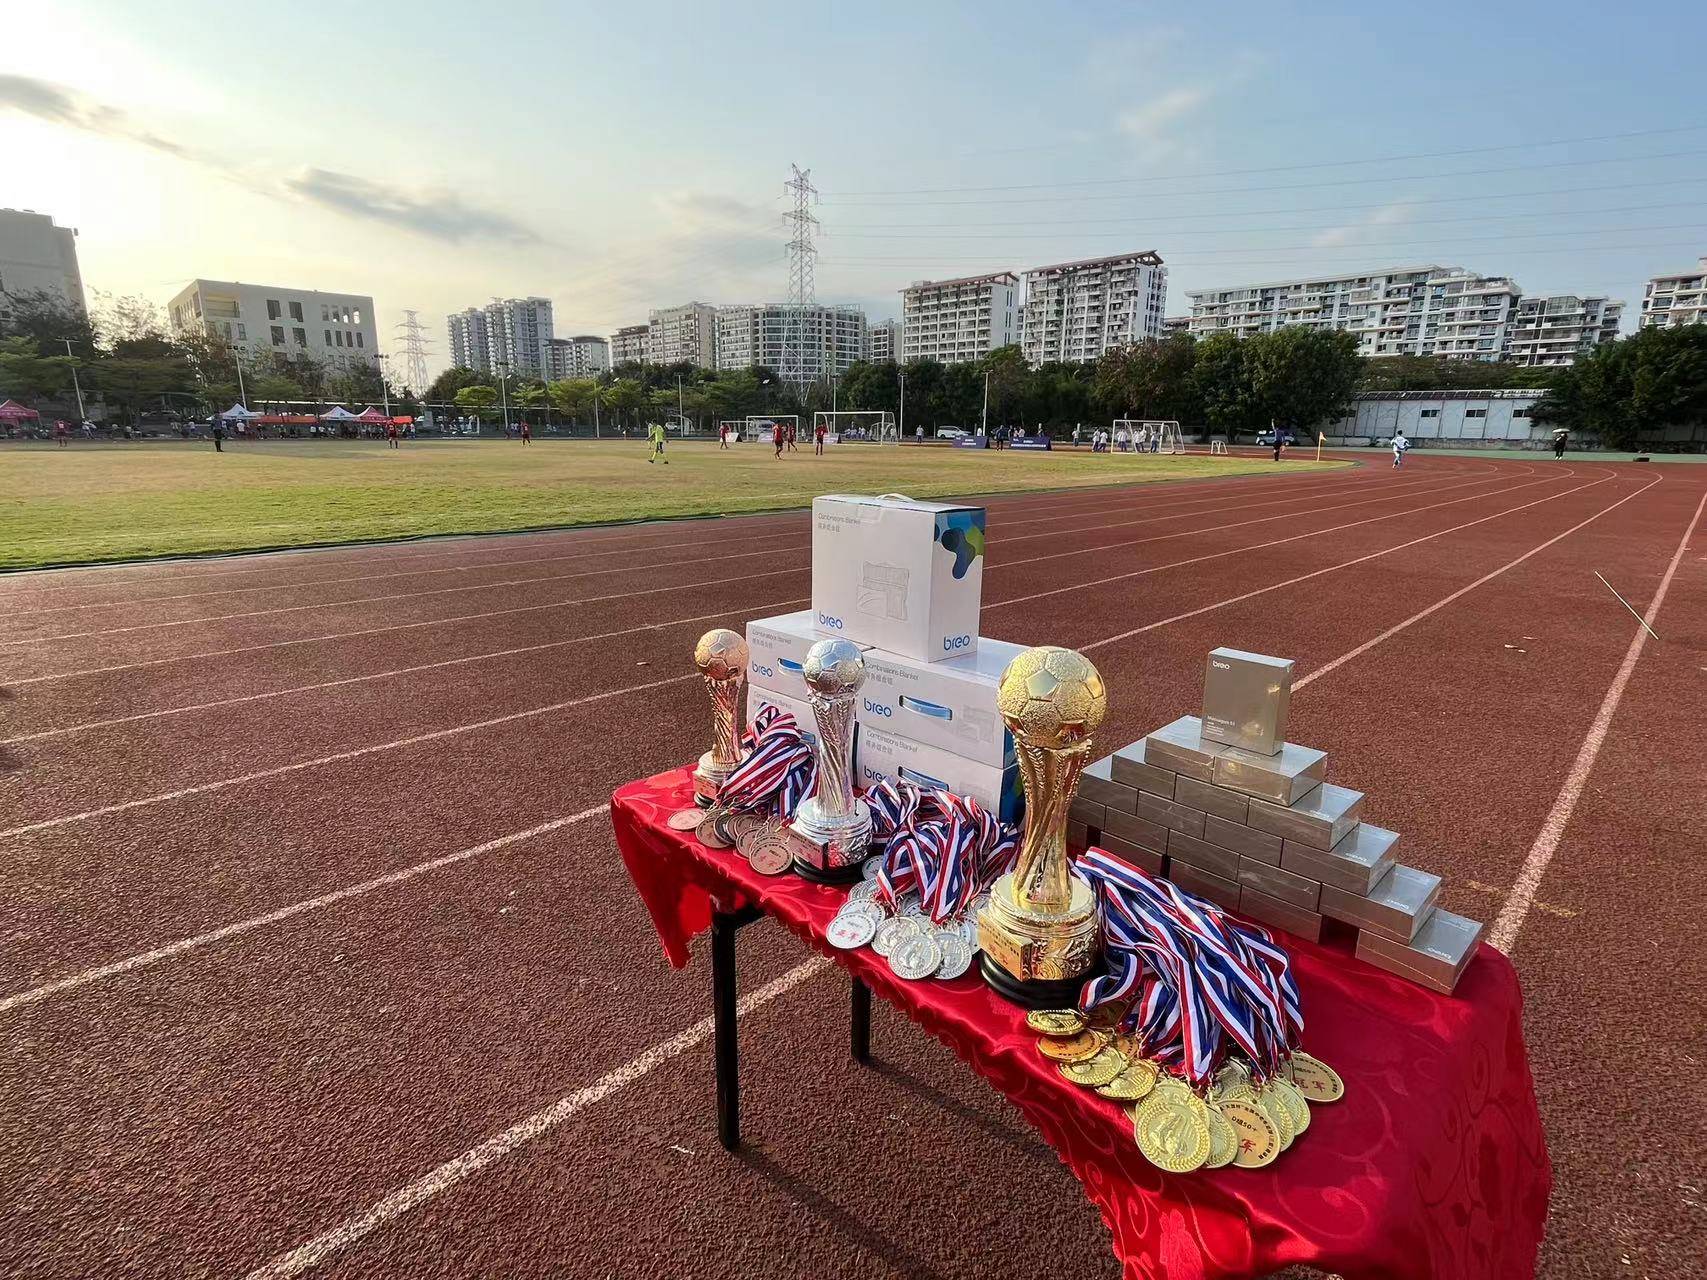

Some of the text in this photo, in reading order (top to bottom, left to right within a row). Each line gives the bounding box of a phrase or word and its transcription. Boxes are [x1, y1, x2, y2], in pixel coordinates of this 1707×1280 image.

[818, 610, 843, 630] breo
[943, 634, 970, 651] breo
[752, 660, 773, 678] breo
[1212, 660, 1230, 670] breo
[863, 697, 892, 718] breo
